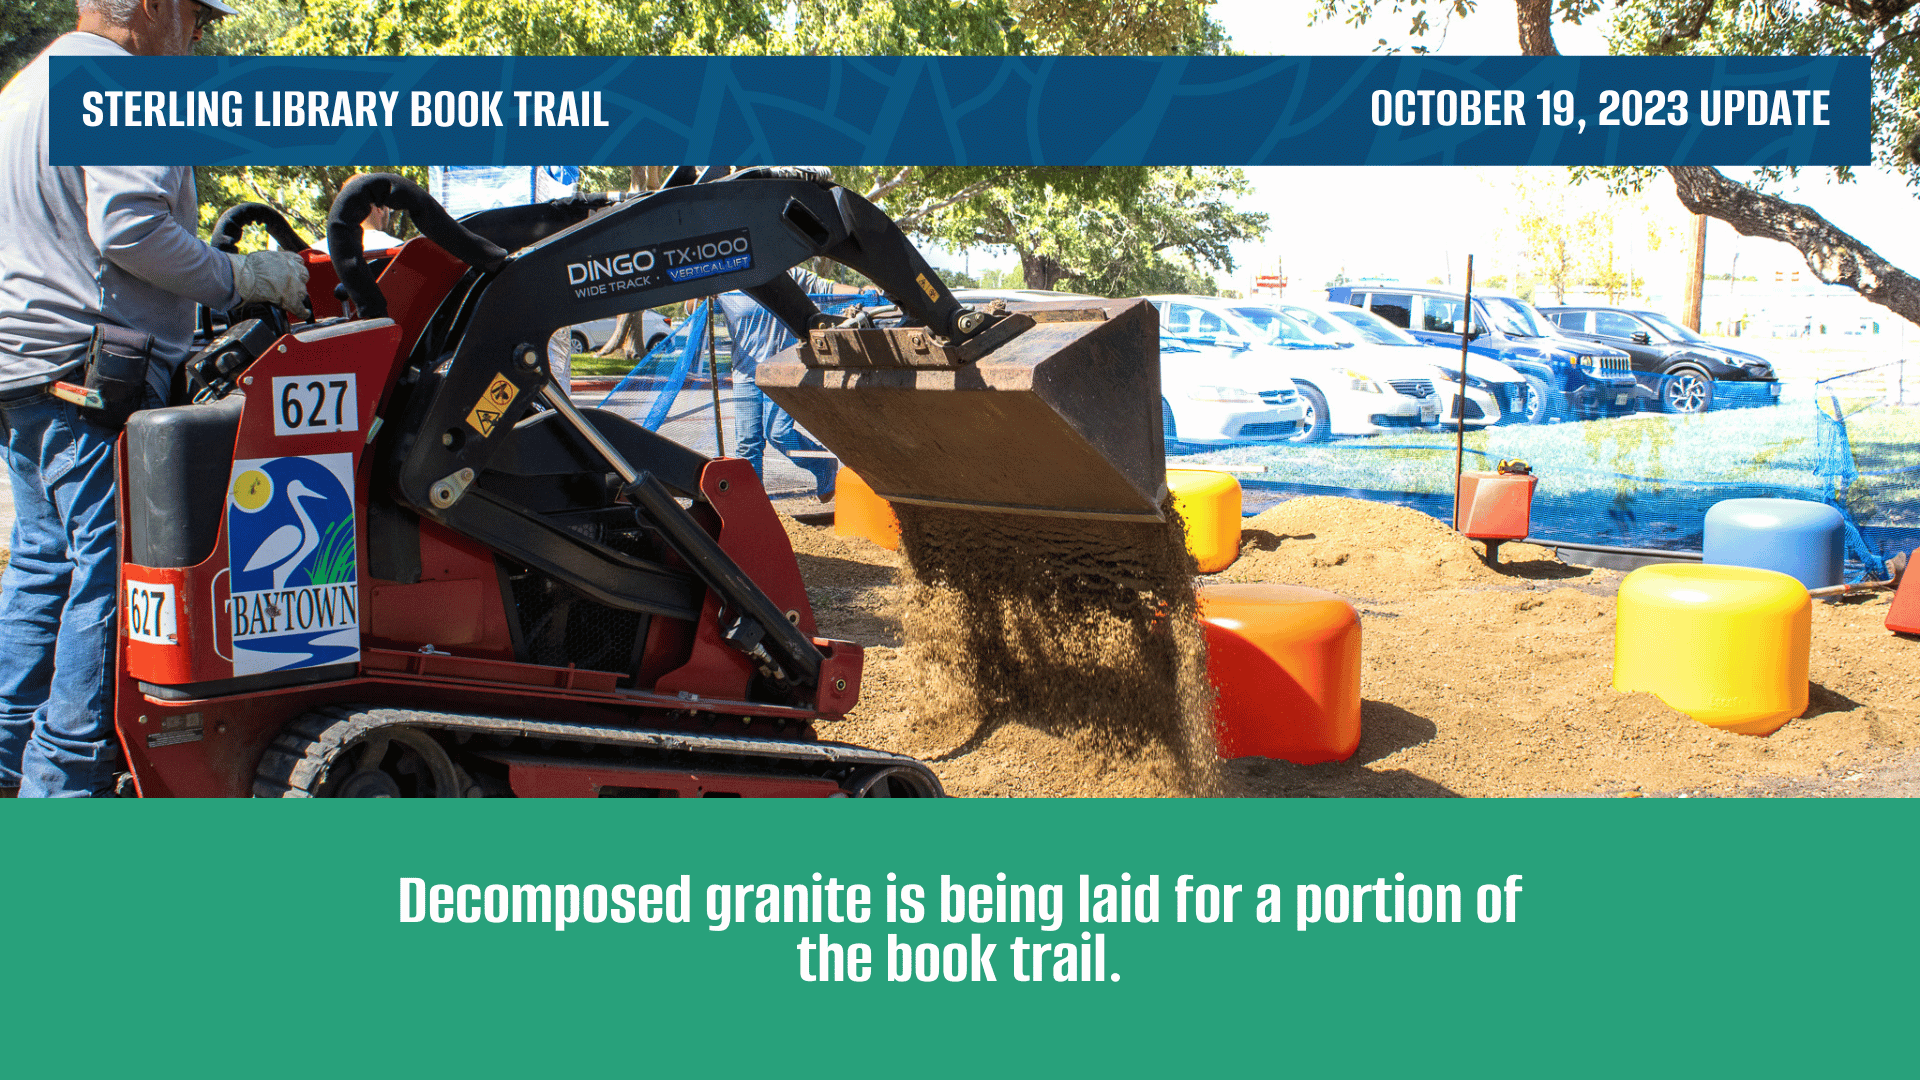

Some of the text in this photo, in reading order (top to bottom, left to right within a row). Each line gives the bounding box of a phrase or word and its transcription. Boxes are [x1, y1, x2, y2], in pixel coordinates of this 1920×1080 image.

[567, 250, 655, 285] DINGO
[574, 275, 651, 298] WIDE TRACK
[670, 256, 749, 279] VERTICAL LIFT
[281, 380, 348, 429] 627
[131, 587, 166, 637] 627
[232, 583, 357, 637] BAYTOWN
